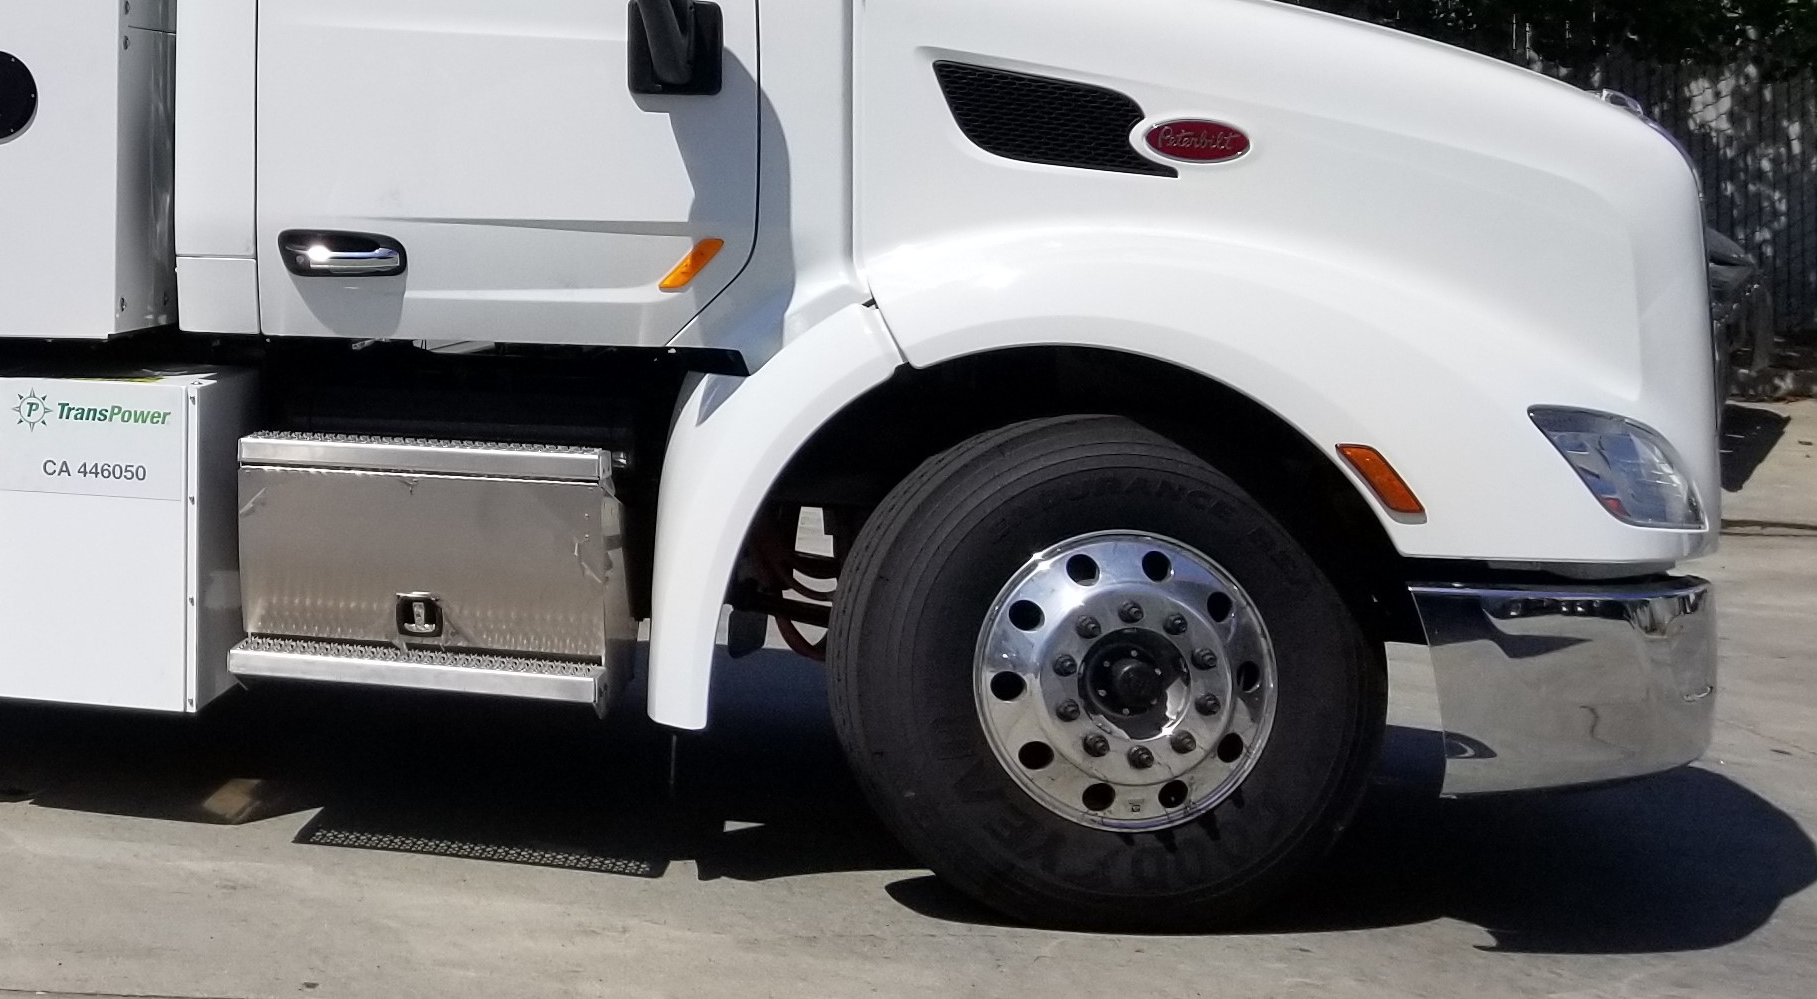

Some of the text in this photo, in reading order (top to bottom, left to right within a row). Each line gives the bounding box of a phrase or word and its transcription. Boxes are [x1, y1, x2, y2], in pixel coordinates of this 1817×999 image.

[1157, 125, 1241, 150] Peterbilt
[57, 402, 172, 426] TransPower
[42, 459, 147, 482] CA 446050
